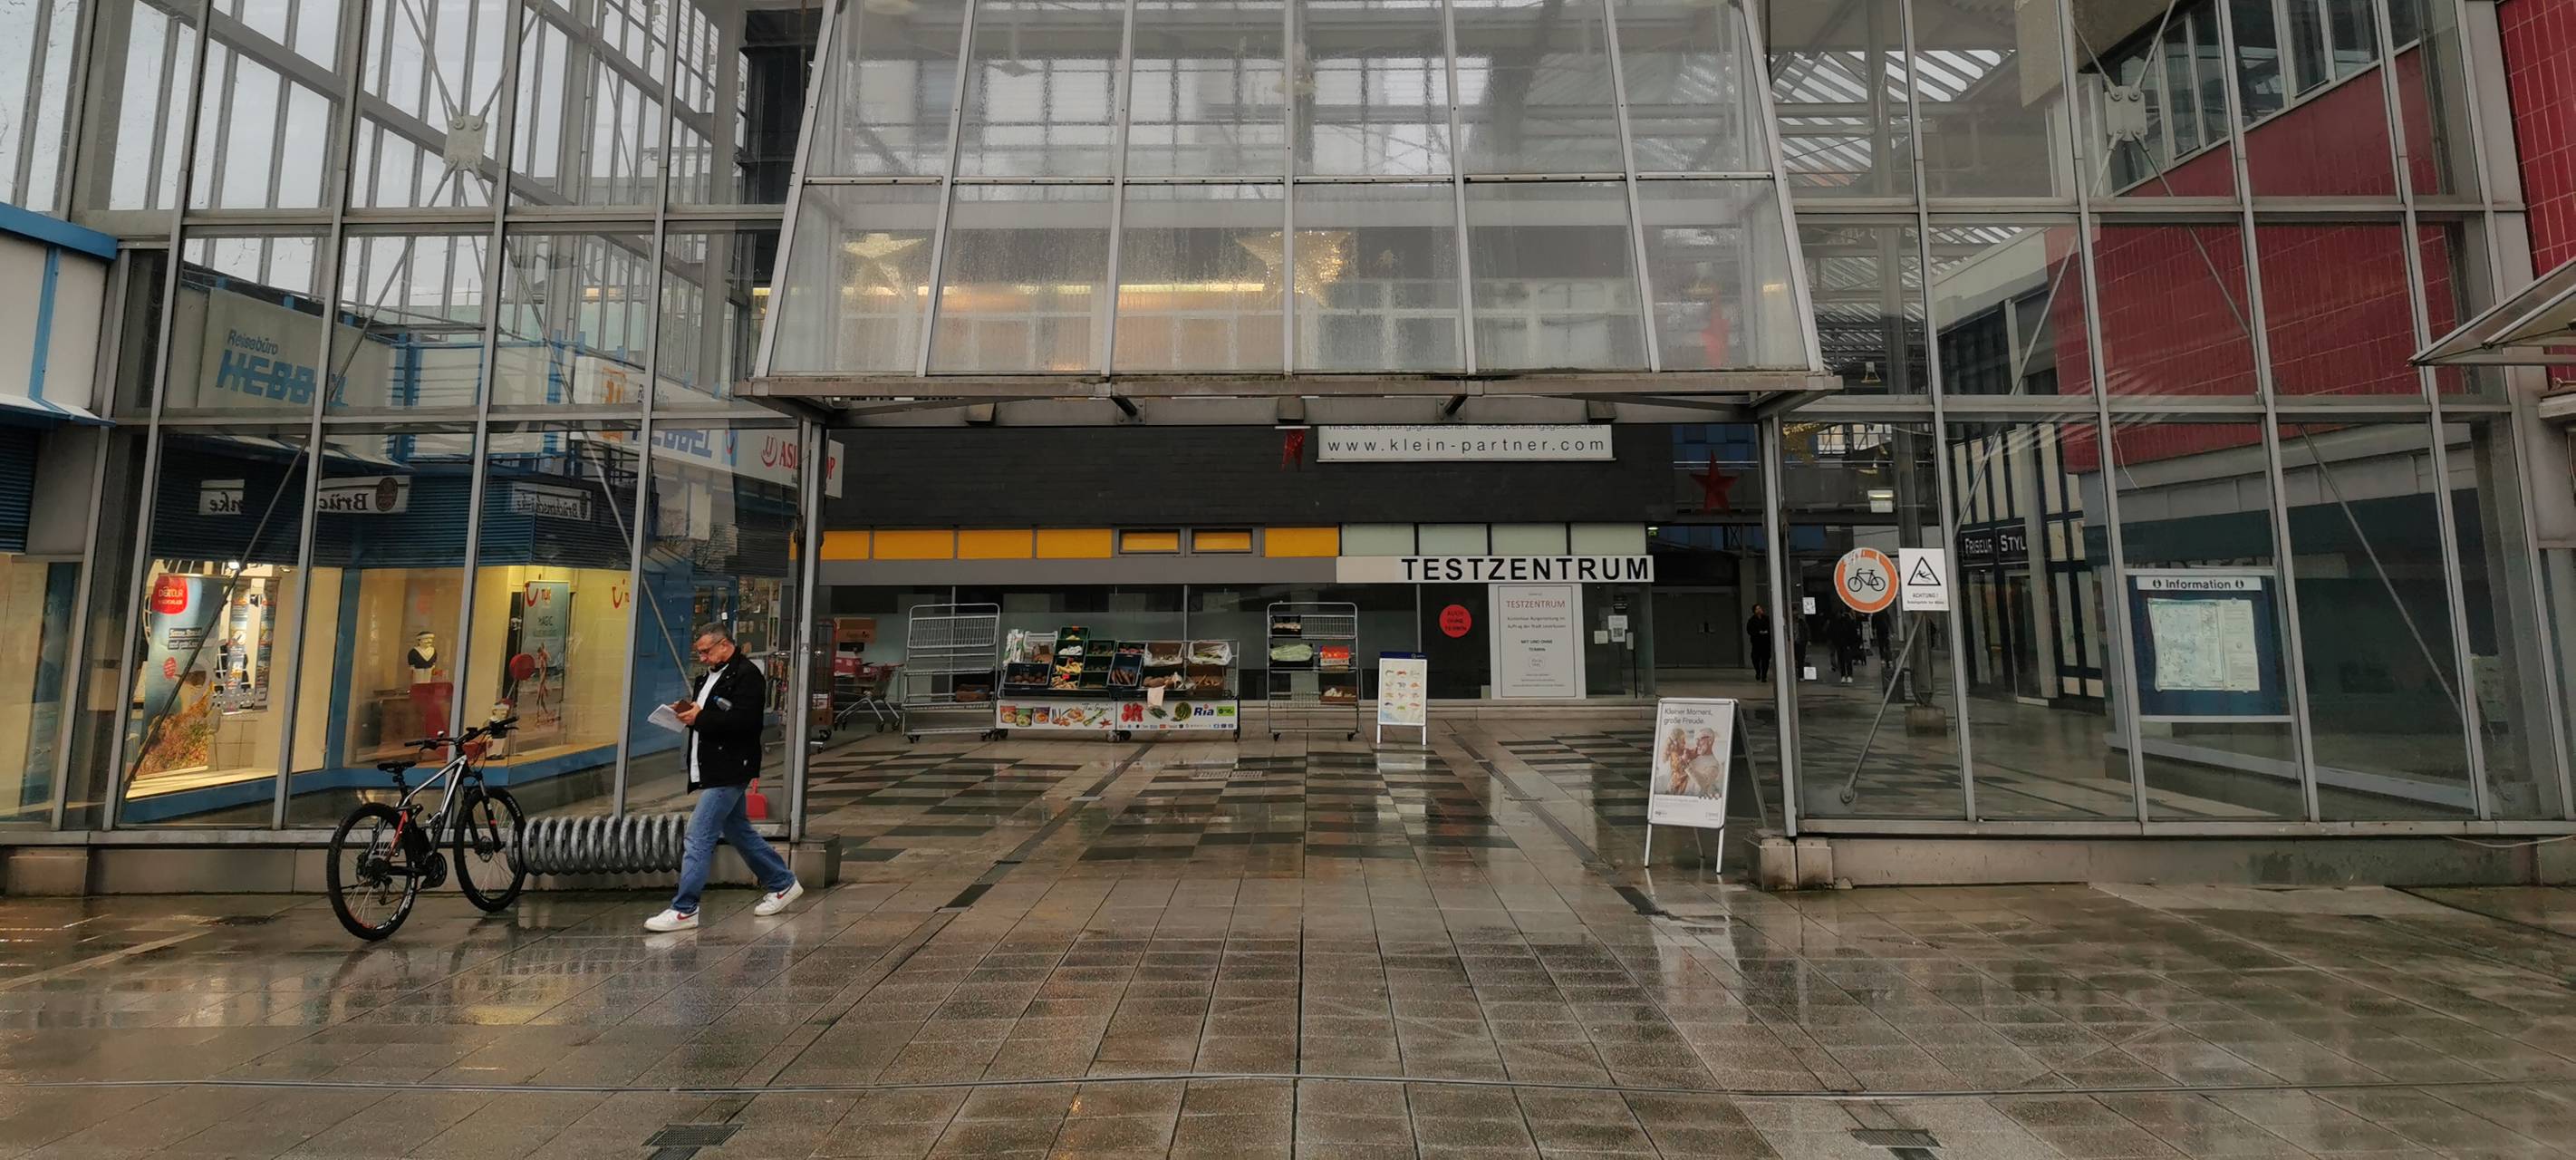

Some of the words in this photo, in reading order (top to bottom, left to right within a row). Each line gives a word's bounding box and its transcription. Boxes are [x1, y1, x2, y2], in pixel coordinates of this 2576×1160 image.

[227, 329, 279, 355] Reisebüro
[215, 348, 349, 407] HEBBL
[778, 441, 798, 469] ASI
[1327, 438, 1605, 454] www.klein-partner.com
[1401, 556, 1649, 581] TESTZENTRUM
[2166, 579, 2232, 589] Information
[1506, 600, 1566, 609] TESTZENTRUM
[1193, 703, 1214, 716] Ria
